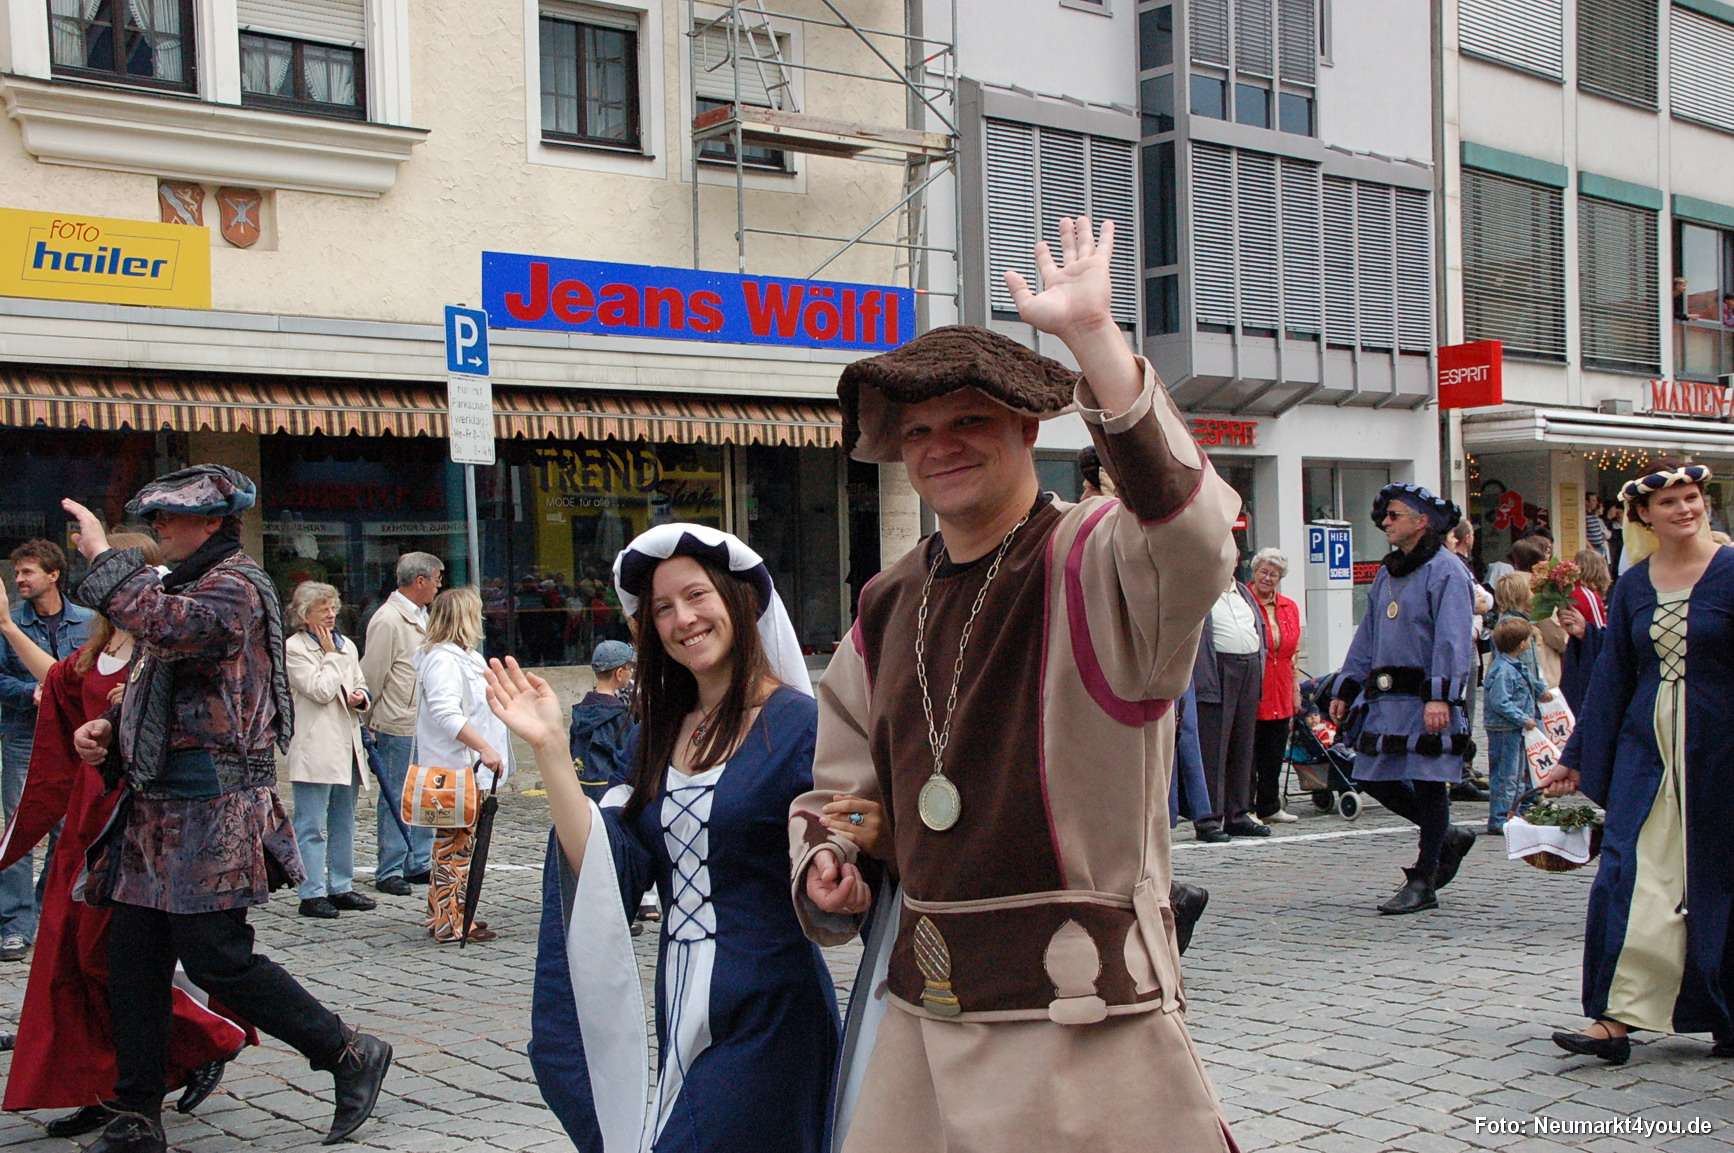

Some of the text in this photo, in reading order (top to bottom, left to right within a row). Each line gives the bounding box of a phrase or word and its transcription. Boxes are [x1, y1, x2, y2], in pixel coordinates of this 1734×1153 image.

[50, 220, 100, 242] FOTO
[33, 241, 168, 278] hailer
[504, 261, 899, 344] Jeans Wölfl
[454, 315, 479, 366] P
[1439, 364, 1491, 387] ESPRIT
[1193, 418, 1259, 446] ESPRIT
[530, 446, 664, 494] TREND
[545, 497, 576, 508] MODE
[579, 496, 591, 508] für
[593, 497, 610, 508] alle
[656, 479, 715, 513] Shop
[1313, 533, 1323, 549] P
[1330, 532, 1349, 542] HIER
[1335, 544, 1345, 566] P
[1330, 568, 1350, 577] SCHEINE
[1553, 724, 1566, 738] M
[1536, 754, 1553, 770] M
